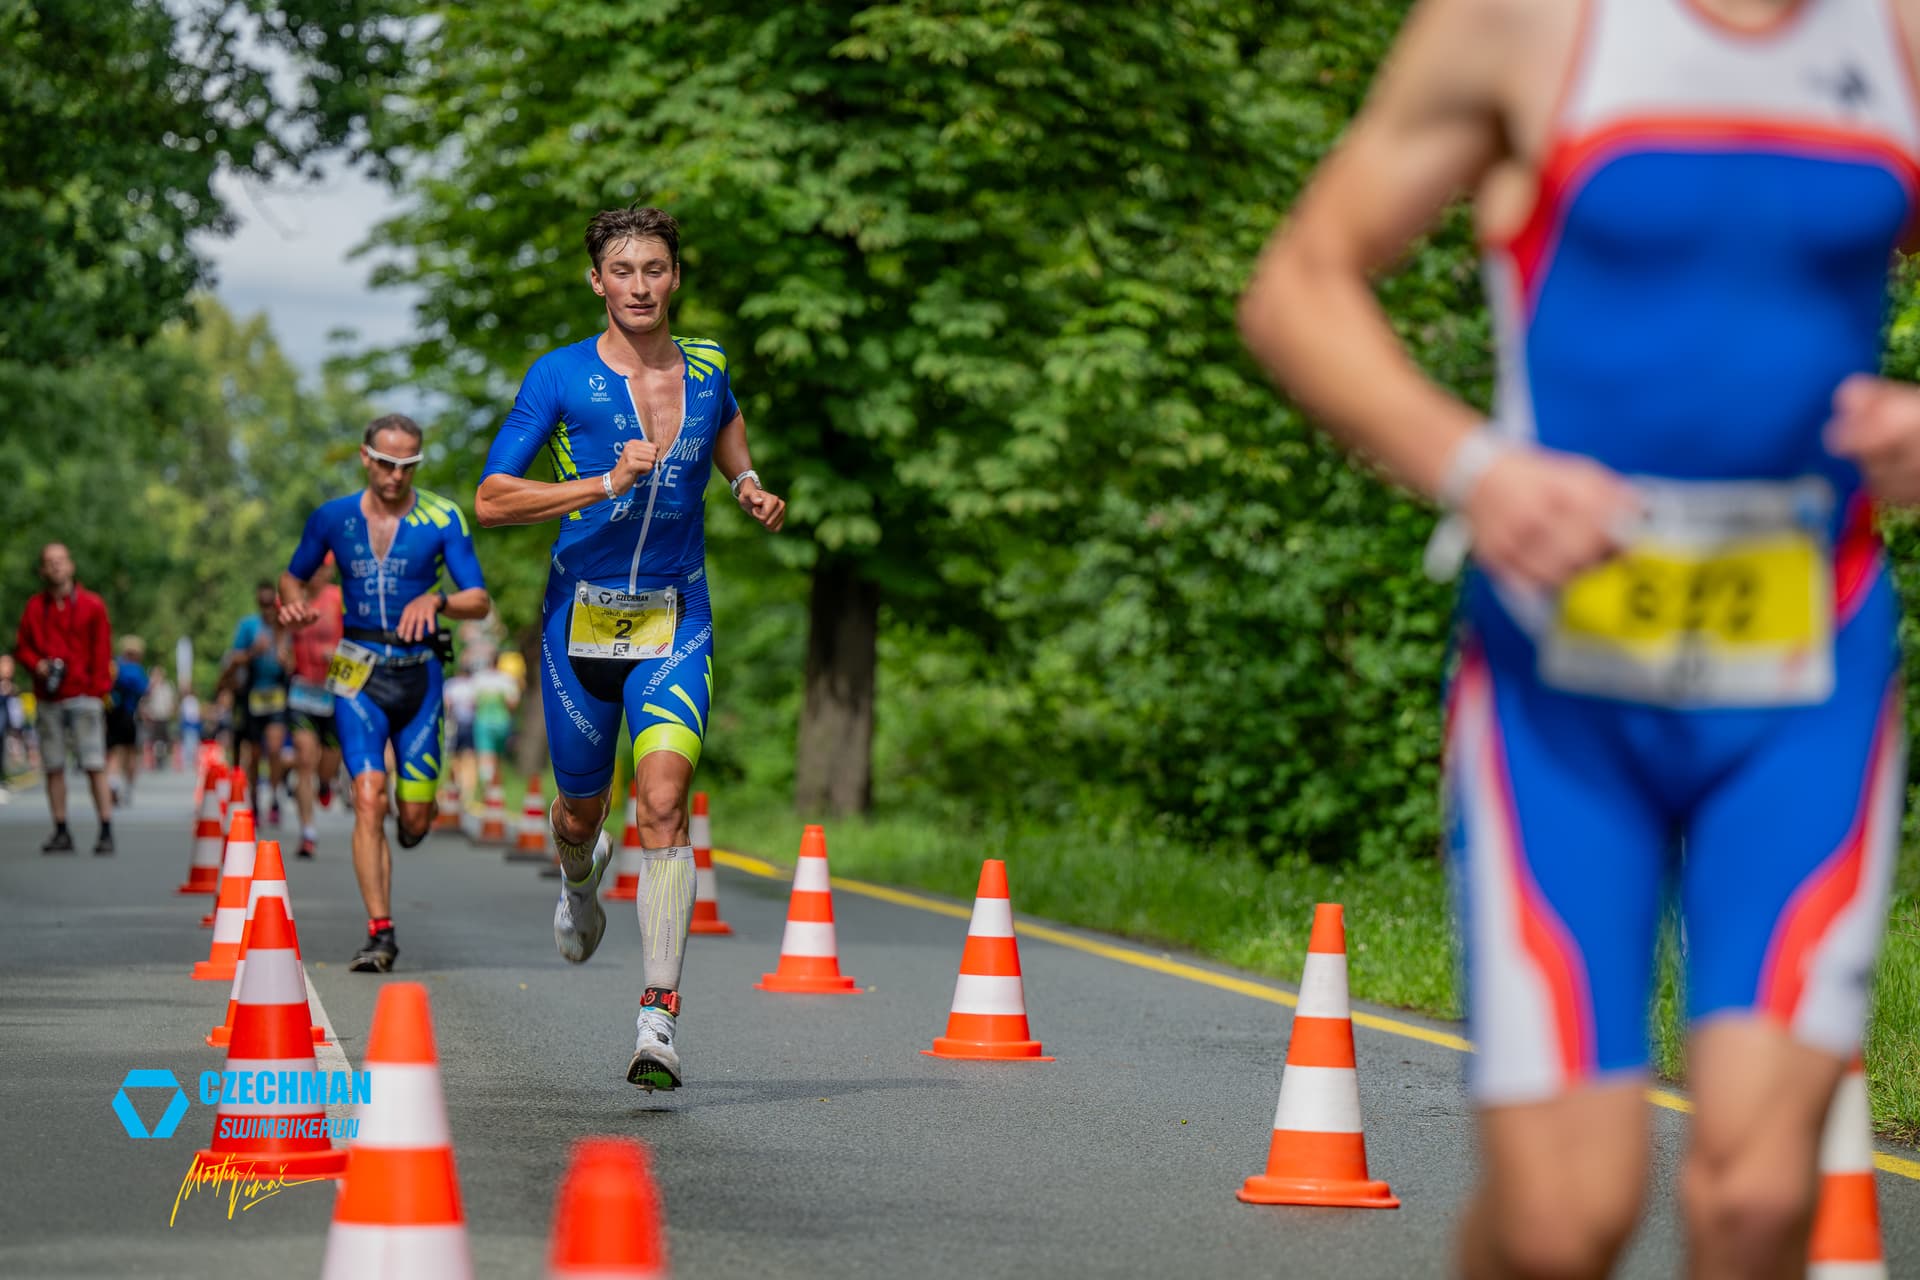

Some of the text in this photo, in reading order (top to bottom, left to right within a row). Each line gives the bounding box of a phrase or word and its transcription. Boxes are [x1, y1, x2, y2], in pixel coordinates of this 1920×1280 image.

[614, 618, 633, 640] 2
[648, 649, 689, 687] BIŽUTERIE
[641, 685, 656, 697] TJ
[557, 687, 593, 734] JABLONEC
